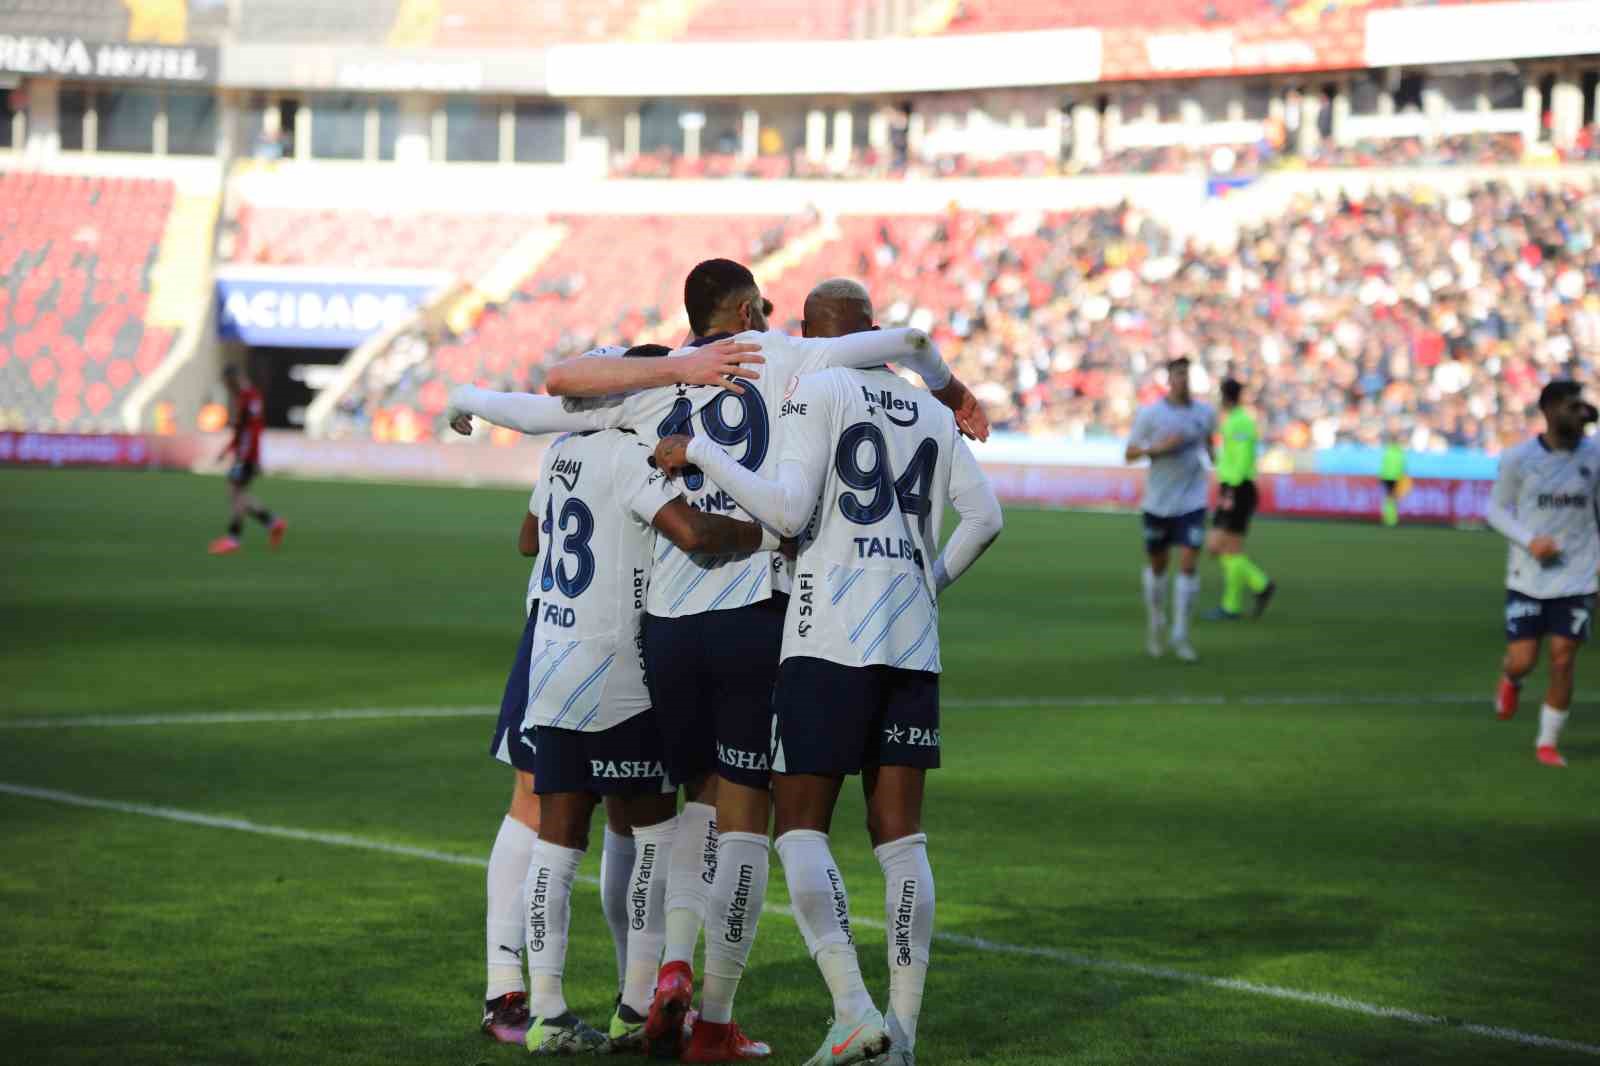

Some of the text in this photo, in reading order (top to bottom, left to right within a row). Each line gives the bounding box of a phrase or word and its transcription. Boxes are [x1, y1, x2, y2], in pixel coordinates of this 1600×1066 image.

[834, 421, 939, 538] 94
[1570, 608, 1589, 635] 7
[590, 758, 666, 779] PASHA
[715, 740, 770, 771] ASHA
